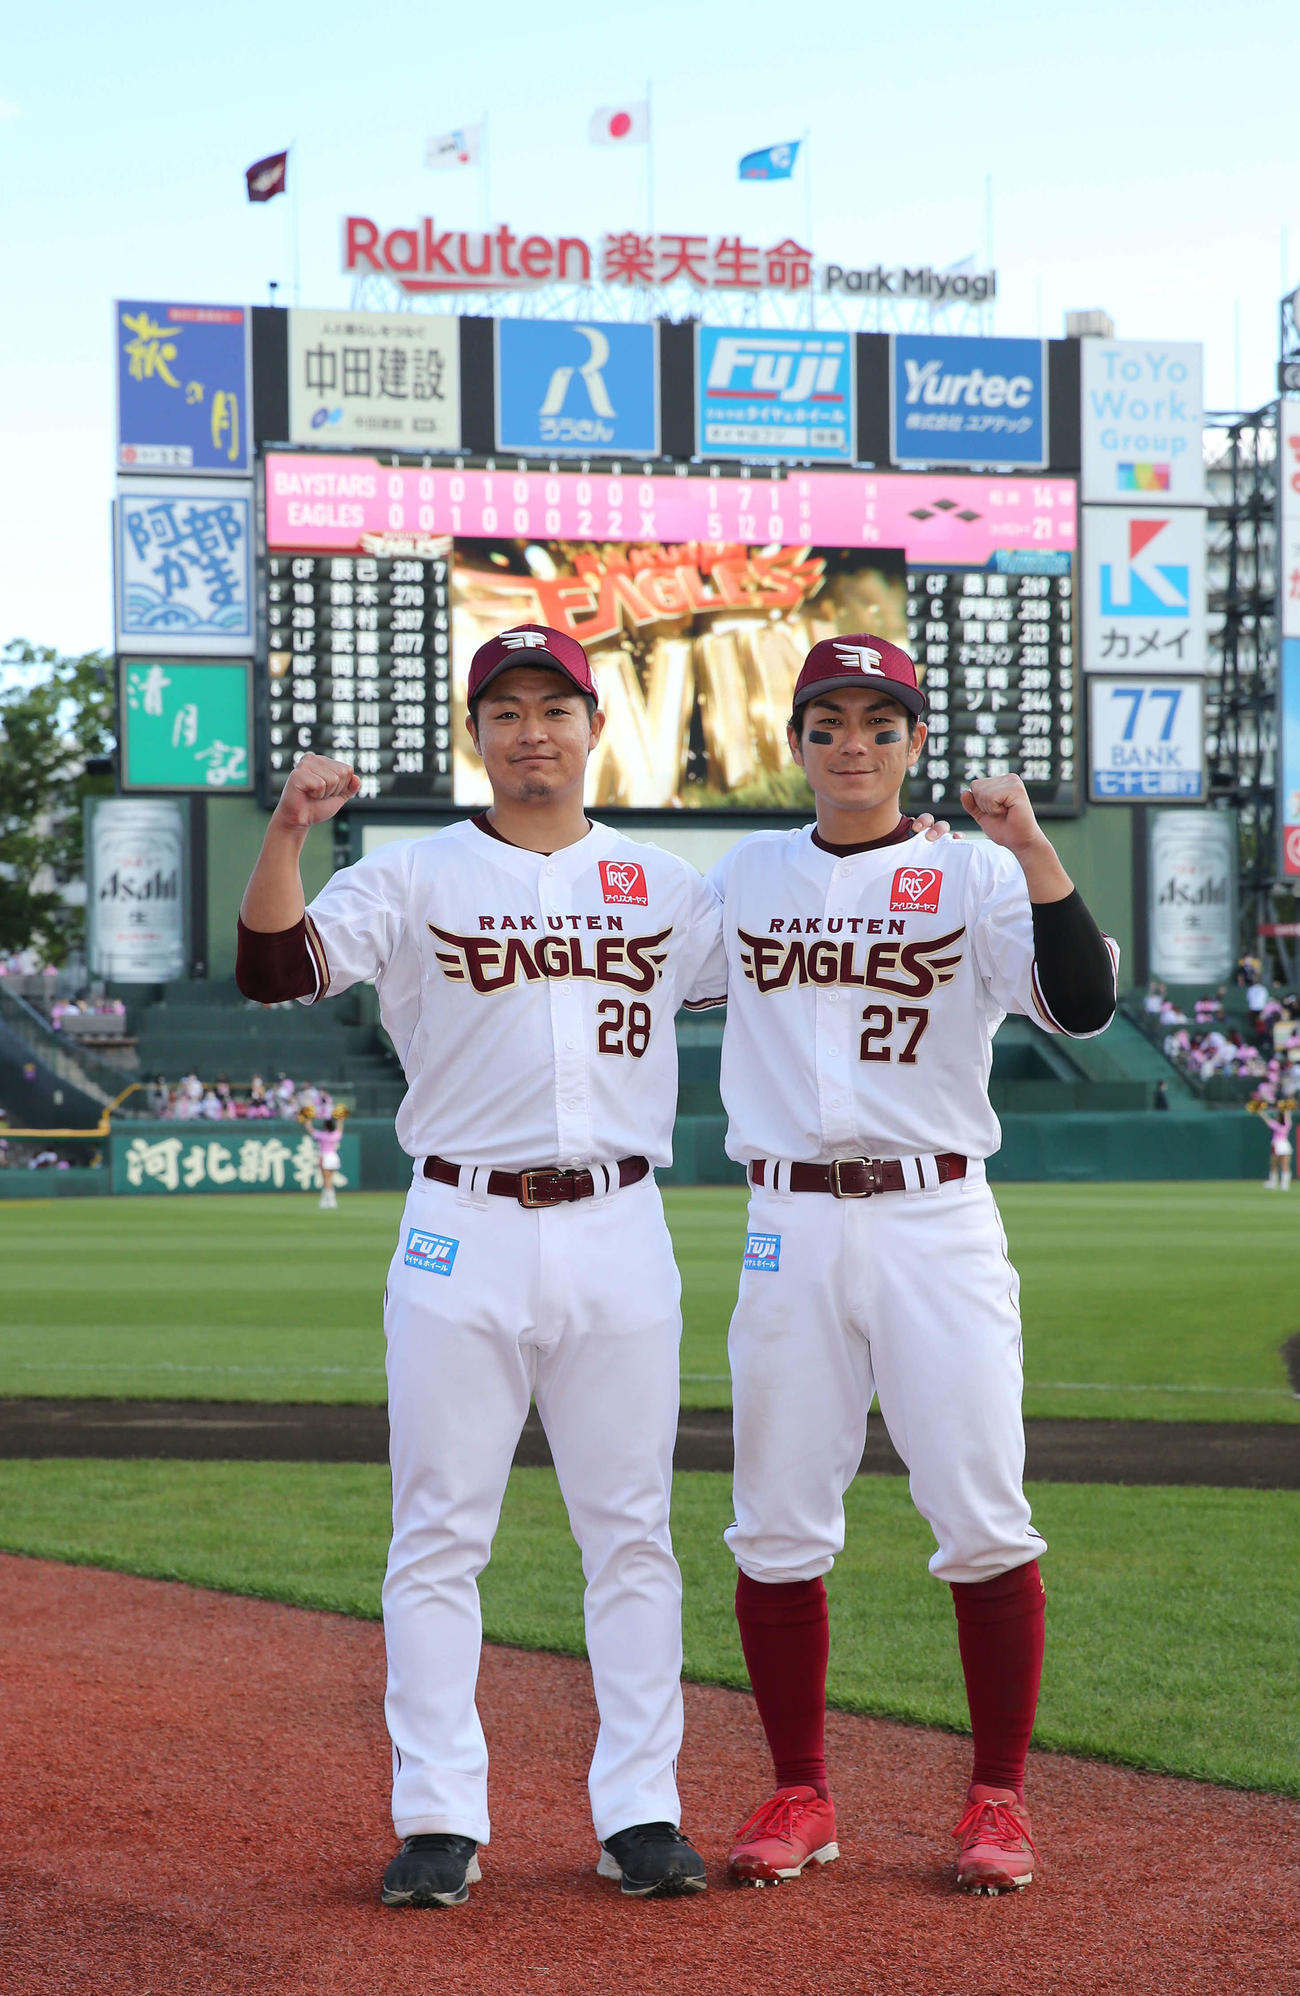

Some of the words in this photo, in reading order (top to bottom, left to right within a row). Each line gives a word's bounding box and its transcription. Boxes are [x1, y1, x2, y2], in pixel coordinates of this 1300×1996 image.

[346, 216, 591, 281] Rakuten
[606, 232, 814, 290] 楽天生命
[826, 265, 894, 294] Park
[902, 269, 997, 303] Miyagi
[305, 341, 446, 400] 中田建設
[706, 337, 845, 402] Fuji
[1101, 350, 1189, 383] ToYo
[904, 358, 1034, 408] Yurtec
[539, 416, 616, 443] ろうきん
[1099, 426, 1189, 460] Group
[275, 471, 376, 499] BAYSTARS
[388, 474, 404, 501] 0
[418, 475, 434, 502] 0
[450, 476, 465, 503] 0
[482, 477, 493, 504] 1
[512, 477, 529, 505] 0
[545, 478, 560, 506] 0
[576, 479, 592, 507] 0
[608, 480, 623, 508] 0
[638, 481, 654, 509] 0
[708, 484, 718, 511] 1
[738, 485, 752, 511] 7
[768, 486, 780, 512] 1
[127, 503, 242, 562] 阿部
[287, 501, 365, 529] EAGLES
[388, 504, 404, 530] 0
[418, 504, 434, 531] 0
[450, 505, 462, 532] 1
[482, 506, 498, 534] 0
[513, 506, 530, 534] 0
[546, 508, 561, 535] 0
[577, 509, 592, 536] 2
[608, 510, 623, 537] 2
[639, 512, 656, 538] X
[707, 512, 722, 539] 5
[738, 514, 756, 541] 12
[768, 515, 784, 540] 0
[432, 560, 447, 583] 7
[434, 586, 446, 607] 1
[1058, 576, 1072, 598] 3
[434, 609, 448, 632] 4
[930, 598, 944, 619] C
[1060, 600, 1071, 622] 1
[292, 630, 316, 652] LF
[434, 632, 448, 655] 0
[925, 621, 949, 643] PR
[1060, 622, 1071, 645] 1
[1100, 629, 1191, 660] カメイ
[434, 656, 448, 679] 3
[965, 690, 1009, 712] ソト
[1060, 691, 1073, 713] 9
[1060, 714, 1073, 736] 9
[1110, 688, 1182, 742] 77
[298, 726, 312, 748] C
[434, 728, 448, 750] 3
[928, 736, 950, 757] LF
[1060, 736, 1074, 758] 0
[436, 751, 447, 774] 1
[1110, 746, 1182, 768] BANK
[1060, 760, 1074, 781] 2
[1096, 769, 1201, 797] 七十七銀行
[932, 782, 946, 804] P
[100, 868, 178, 902] Asahi
[1158, 876, 1228, 908] Asahi
[605, 894, 647, 904] アイリスオーヤマ
[891, 902, 937, 912] アイリスオーヤマ
[478, 915, 624, 931] RAKUTEN
[768, 918, 906, 935] RAKUTEN
[426, 921, 674, 995] EAGLES
[737, 925, 967, 1000] EAGLES
[596, 999, 651, 1058] 28
[859, 1004, 930, 1064] 27
[409, 1232, 454, 1259] Fuji
[747, 1236, 777, 1258] Fuji
